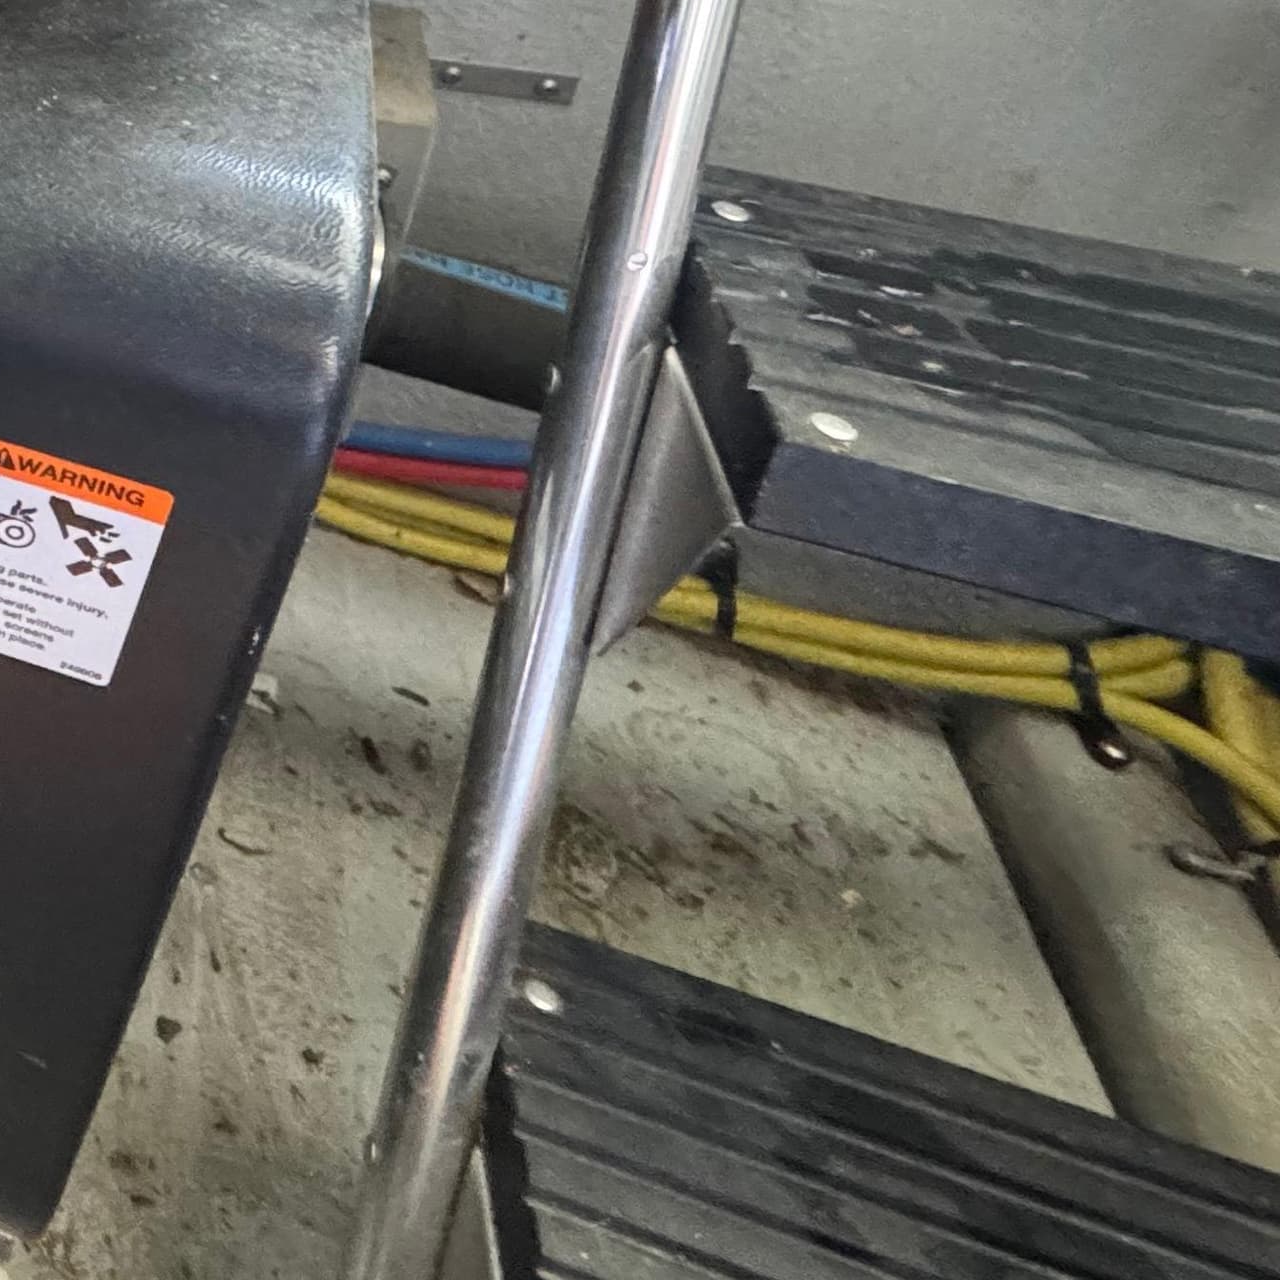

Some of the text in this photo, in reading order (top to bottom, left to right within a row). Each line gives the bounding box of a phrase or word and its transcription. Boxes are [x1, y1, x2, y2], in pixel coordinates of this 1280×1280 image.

[17, 455, 144, 507] WARNING
[18, 584, 64, 603] severe
[2, 609, 22, 621] set
[25, 616, 74, 637] without
[3, 621, 54, 642] screens
